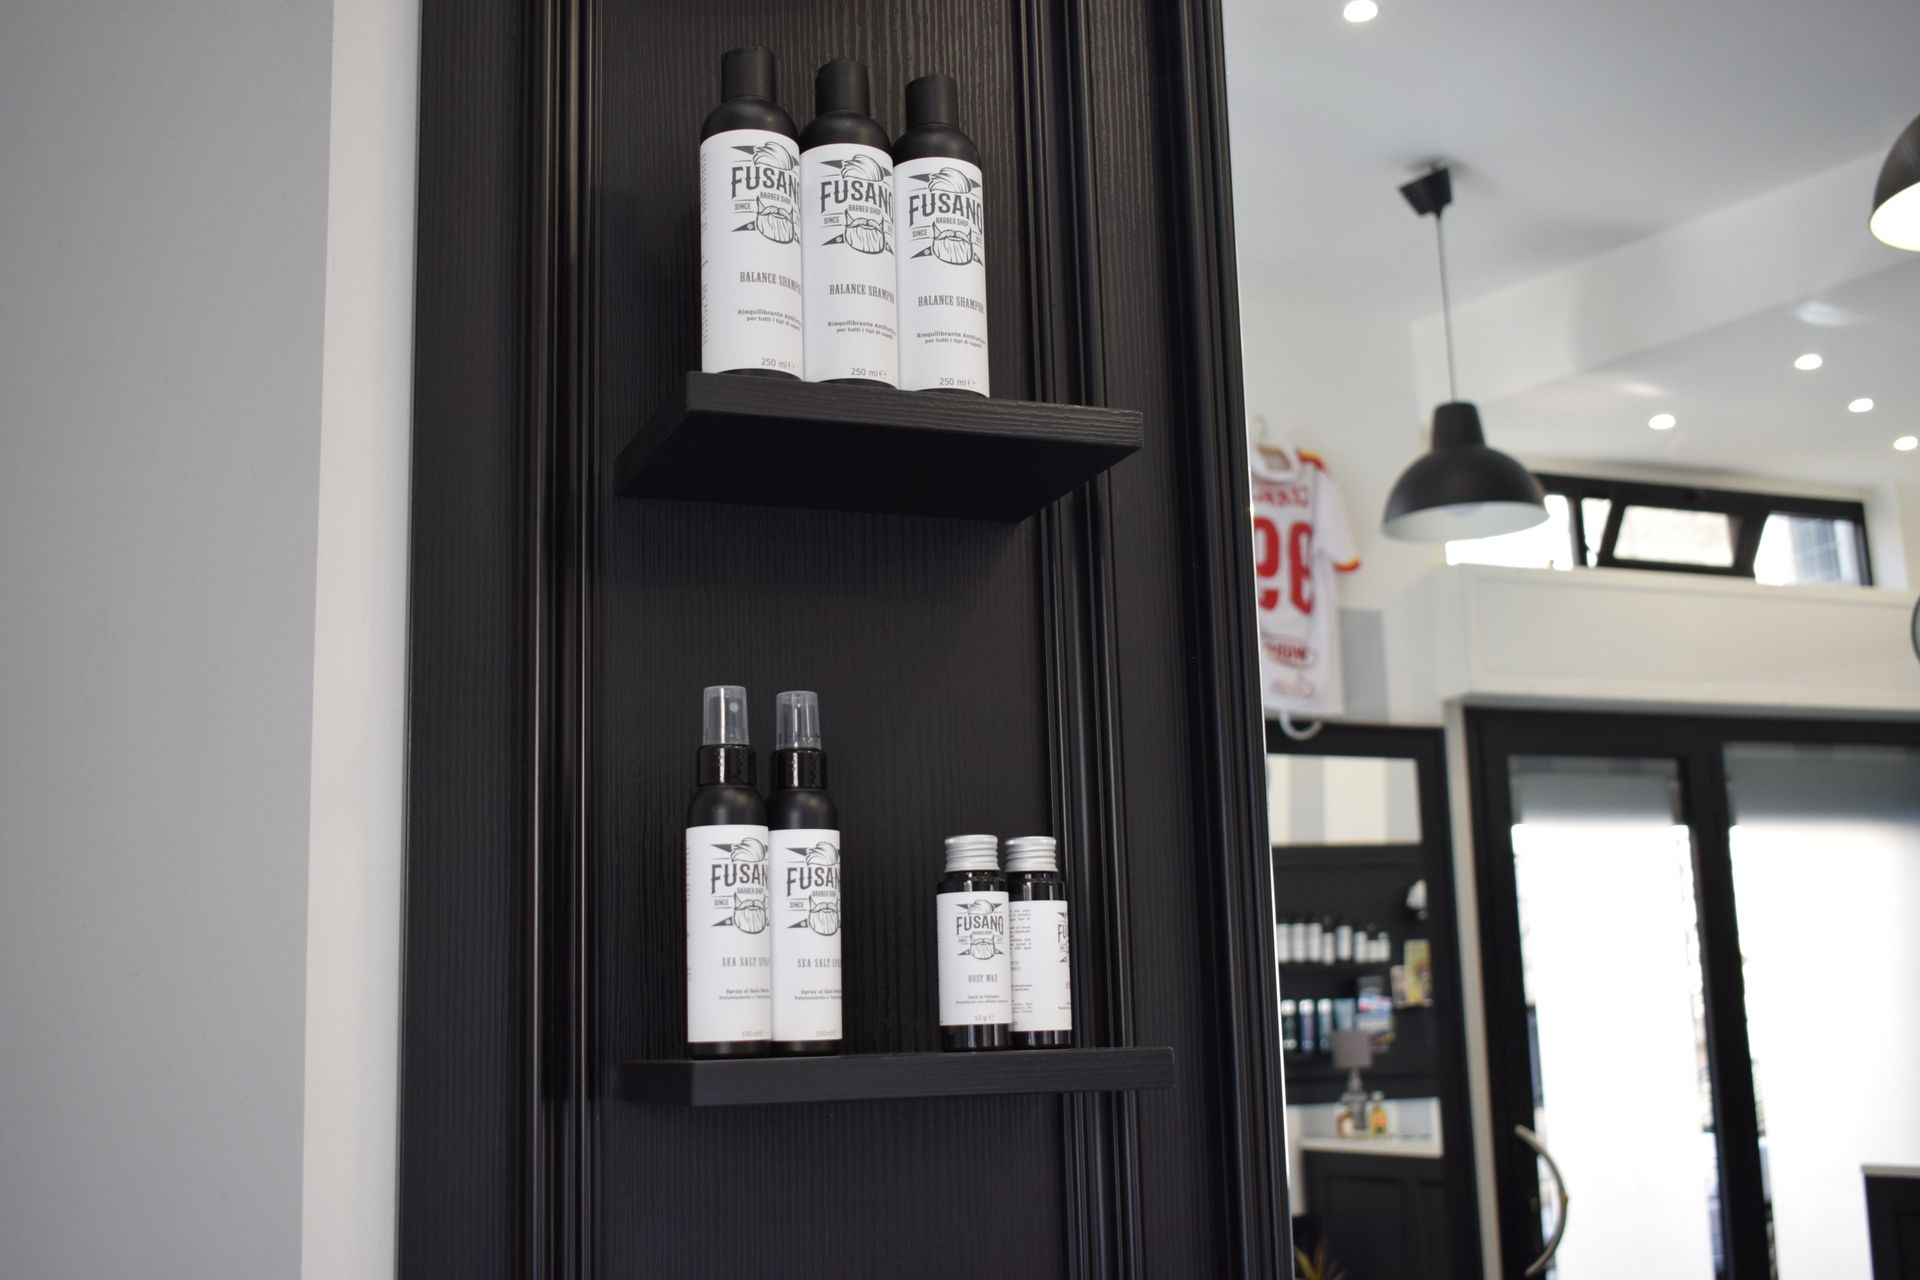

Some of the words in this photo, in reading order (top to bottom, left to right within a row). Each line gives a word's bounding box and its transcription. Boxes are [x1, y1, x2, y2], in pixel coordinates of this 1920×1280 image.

[734, 202, 751, 210] SINCE
[820, 180, 894, 225] FUSANO
[909, 193, 983, 235] FUSANO
[823, 216, 840, 225] SINCE
[935, 217, 957, 225] BARBER
[912, 229, 928, 238] SINCE
[739, 271, 777, 285] BALANCE
[829, 283, 866, 296] BALANCE
[917, 295, 954, 307] BALANCE
[760, 357, 777, 367] 250
[850, 367, 867, 376] 250
[868, 369, 878, 377] ml
[939, 377, 955, 386] 250
[956, 378, 967, 387] ml
[955, 914, 1004, 936] FUSANO
[721, 957, 737, 967] SEA
[739, 956, 756, 967] SALT
[797, 958, 812, 968] SEA
[814, 958, 830, 968] SALT
